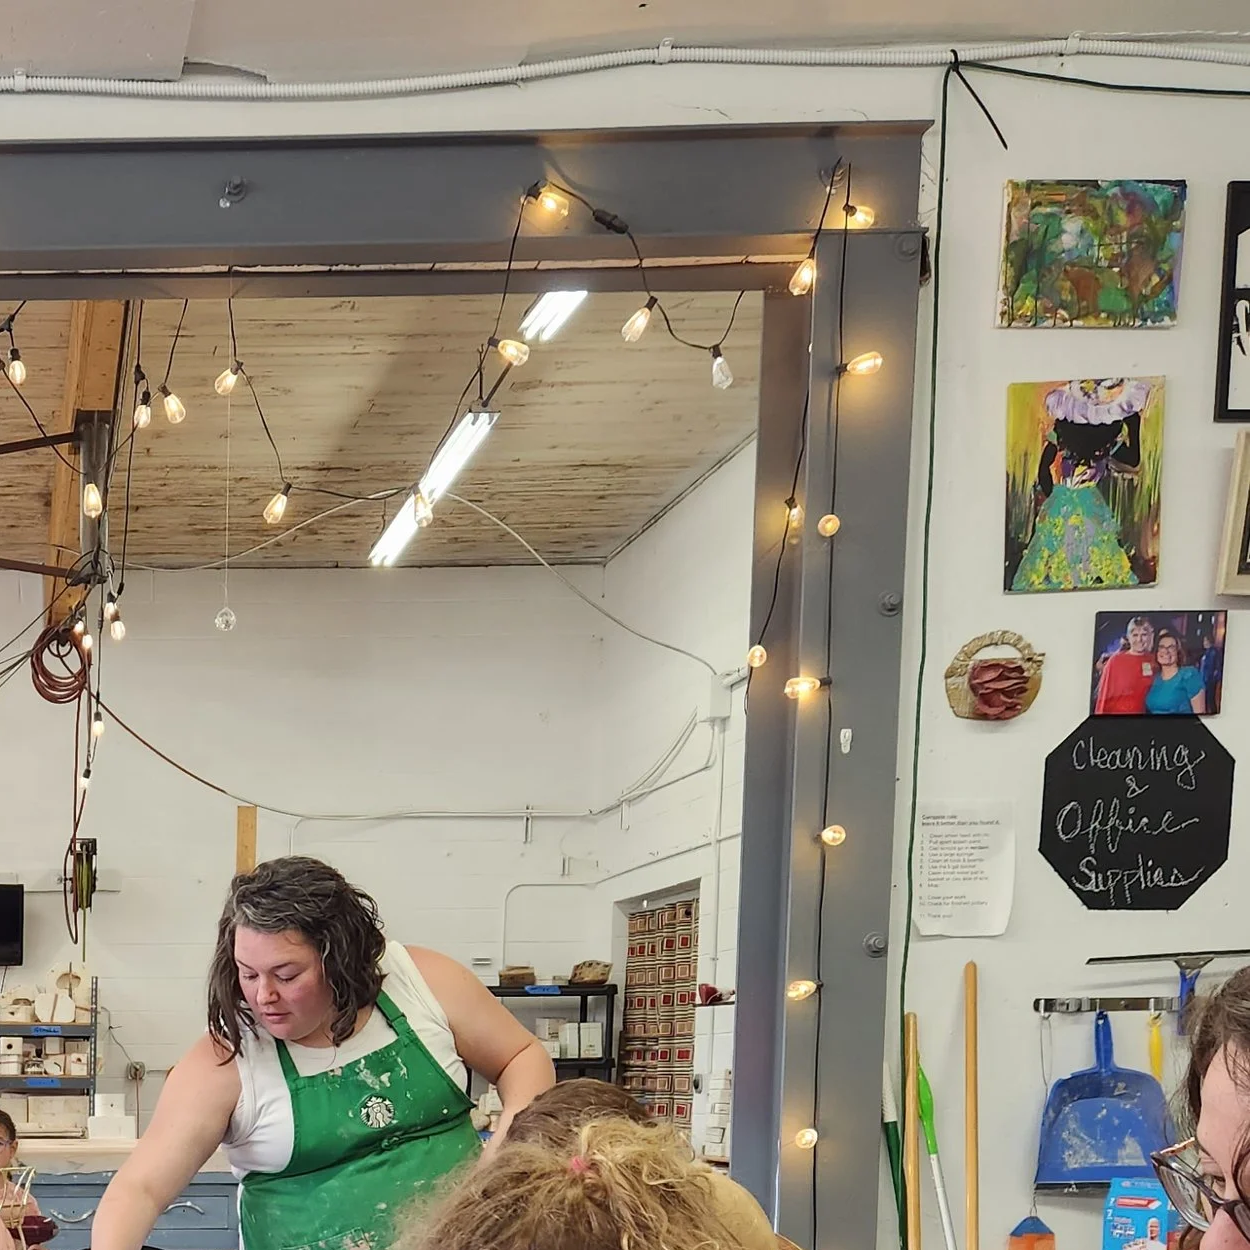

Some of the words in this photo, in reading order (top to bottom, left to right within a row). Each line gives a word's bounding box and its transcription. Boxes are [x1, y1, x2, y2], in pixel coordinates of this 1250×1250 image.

[1072, 736, 1206, 790] Cleaning
[1056, 797, 1200, 854] Office
[1072, 854, 1206, 906] Supplies
